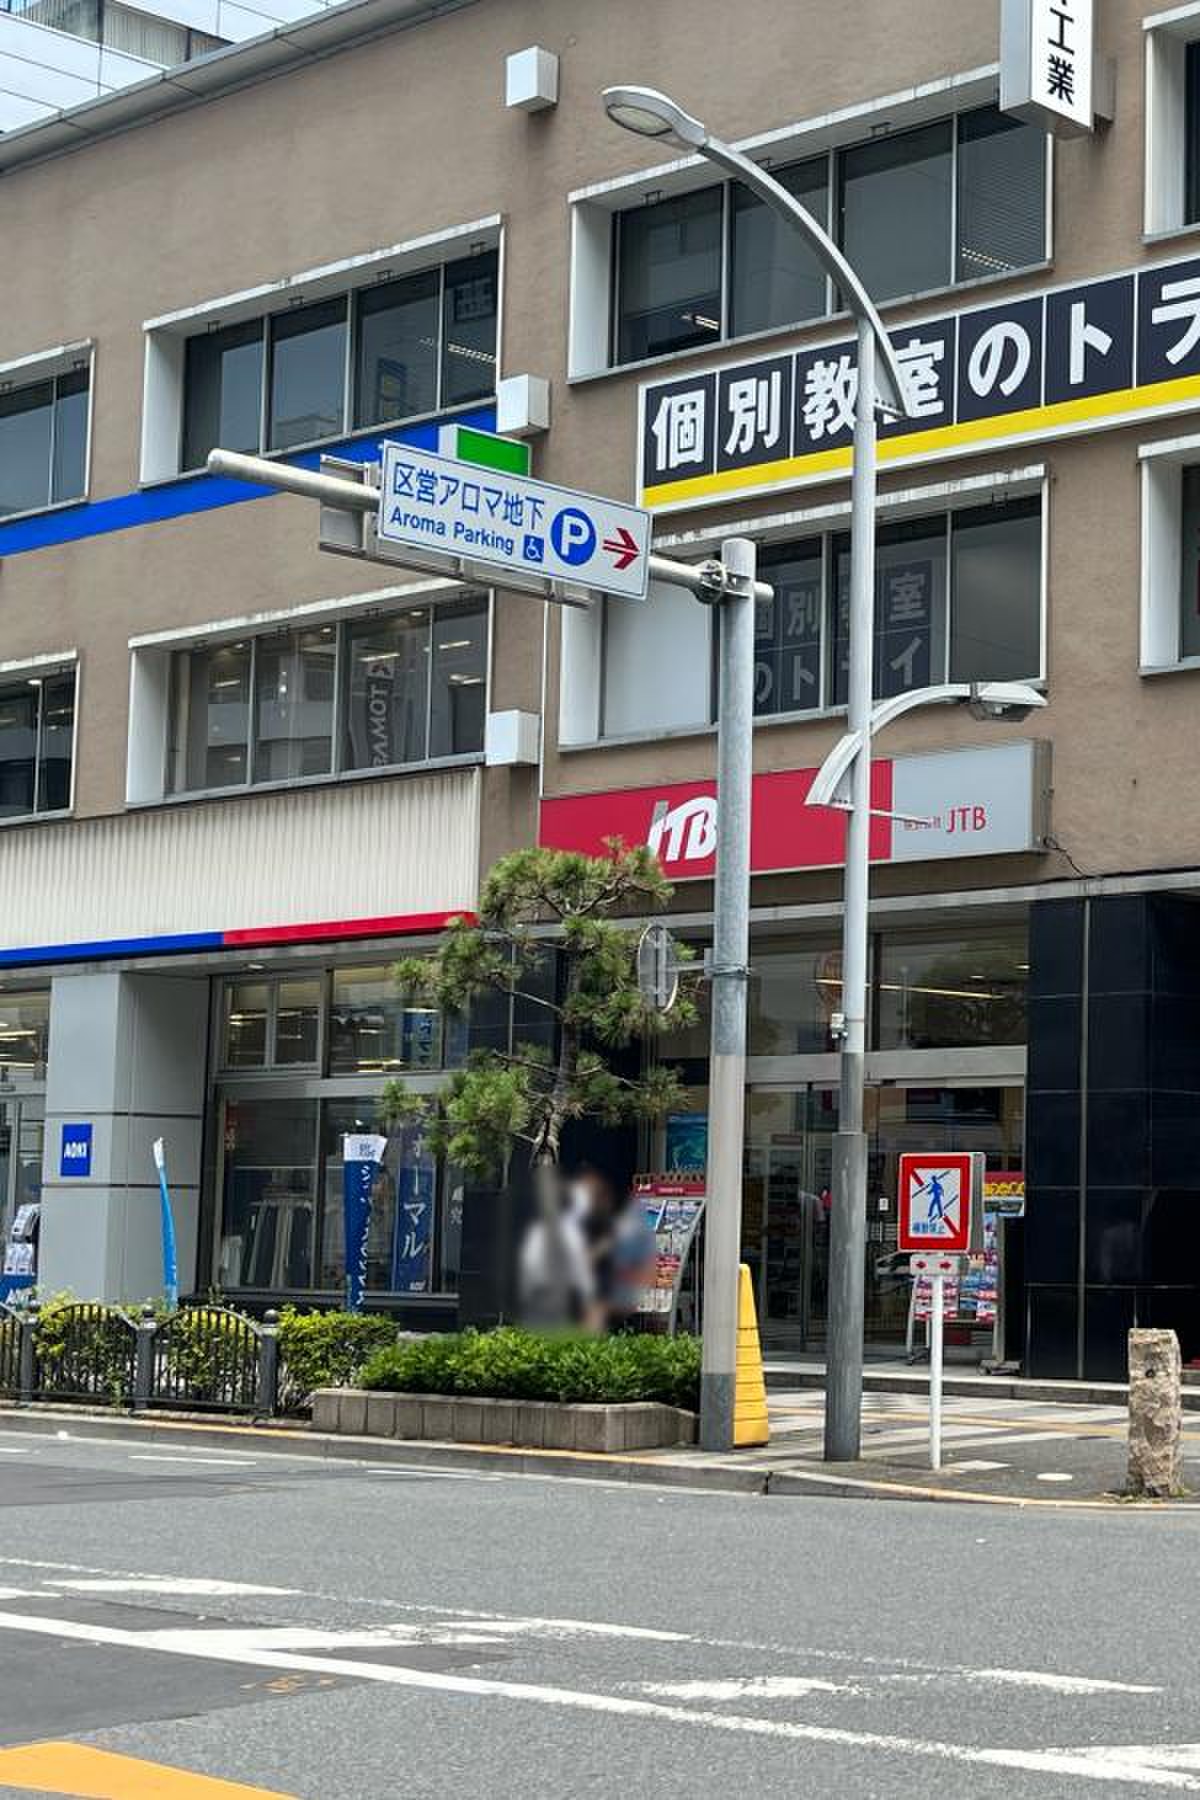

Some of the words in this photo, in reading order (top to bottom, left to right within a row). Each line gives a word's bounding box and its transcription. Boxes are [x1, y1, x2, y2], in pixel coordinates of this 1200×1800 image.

[1047, 0, 1076, 106] 工業
[393, 462, 545, 531] 区営アロマ地下
[391, 506, 446, 536] Aroma
[453, 521, 515, 556] Parking
[560, 514, 590, 556] P
[647, 796, 718, 862] JTB
[946, 805, 987, 835] JTB
[63, 1142, 88, 1159] AOKI
